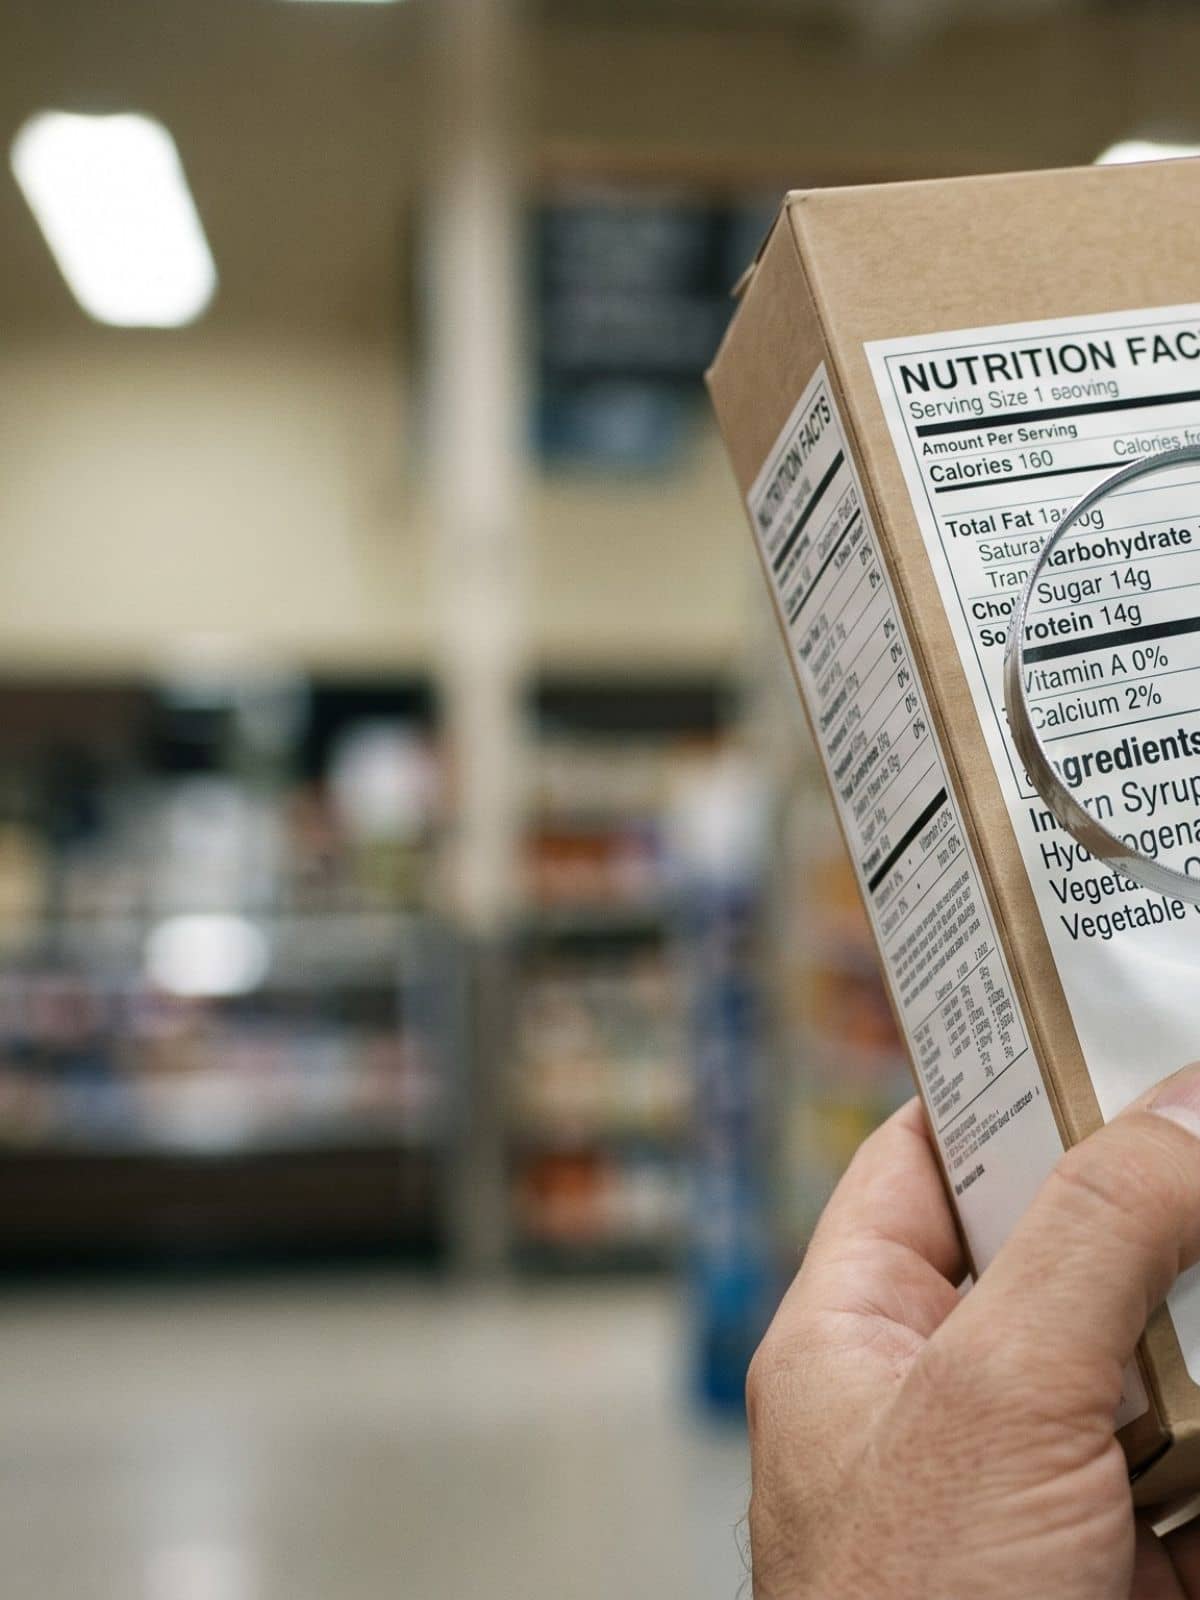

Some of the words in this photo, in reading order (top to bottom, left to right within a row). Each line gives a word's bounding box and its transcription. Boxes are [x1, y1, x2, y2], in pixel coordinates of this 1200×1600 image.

[899, 341, 1117, 394] NUTRITION
[909, 397, 984, 420] Serving
[988, 390, 1028, 409] Size
[1034, 387, 1044, 403] 1
[799, 396, 831, 460] FACTS
[922, 436, 984, 456] Amount
[987, 431, 1014, 447] Per
[1018, 424, 1079, 442] Serving
[1113, 434, 1180, 456] Calories
[930, 457, 1013, 483] Calories
[1018, 450, 1054, 470] 160
[945, 515, 997, 538] Total
[1001, 509, 1035, 531] Fat
[985, 569, 1029, 588] Tran
[1037, 576, 1103, 604] Sugar
[1110, 567, 1152, 590] 14g
[979, 628, 1008, 647] So
[1025, 612, 1094, 641] rotein
[1100, 603, 1142, 626] 14g
[1025, 659, 1104, 694] Vitamin
[1111, 653, 1128, 677] A
[1133, 645, 1169, 671] 0%
[1031, 696, 1120, 729] Calcium
[1125, 683, 1163, 710] 2%
[1049, 870, 1144, 905] Vegeta
[1060, 896, 1187, 941] Vegetable
